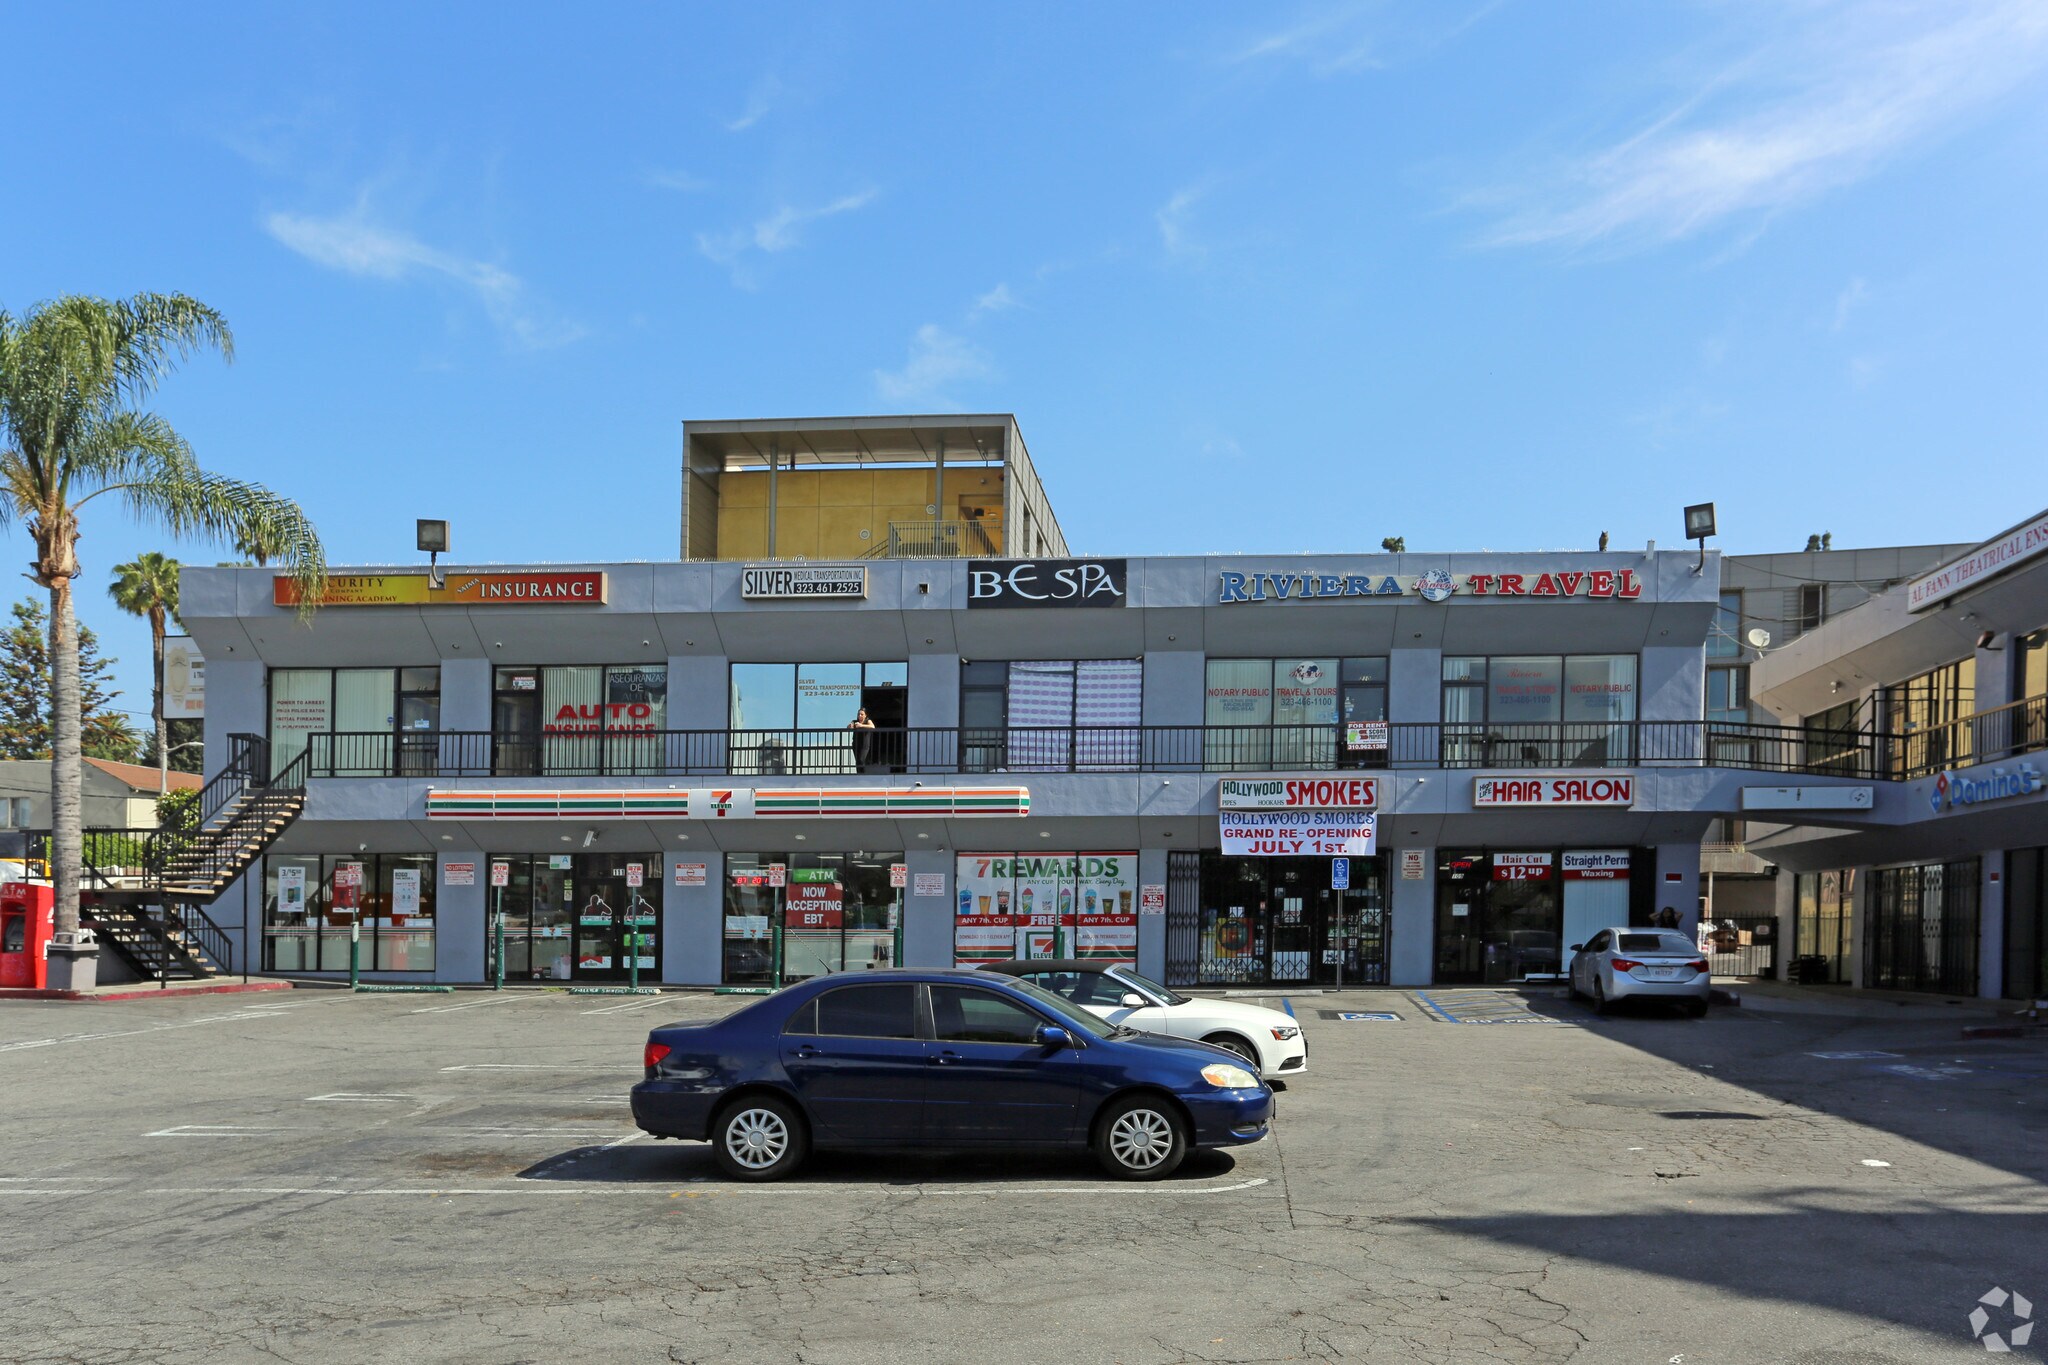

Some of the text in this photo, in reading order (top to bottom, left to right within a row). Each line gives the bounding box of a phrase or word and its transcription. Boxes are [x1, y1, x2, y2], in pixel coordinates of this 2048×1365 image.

[1912, 586, 1923, 604] AL
[1926, 571, 1951, 597] FANN
[1956, 536, 2022, 583] THEATRICAL
[326, 577, 385, 588] CURITY
[745, 570, 792, 595] SILVER
[794, 571, 813, 580] MEDICAL
[814, 570, 853, 580] TRANSPORTATION
[969, 564, 1124, 599] BE SPA
[1220, 570, 1403, 602] RIVIERA
[1468, 568, 1642, 599] TRAVEL
[480, 582, 593, 597] INSURANCE
[796, 583, 859, 593] 323.461.2525
[609, 673, 666, 683] ASEGURANZAS
[629, 684, 643, 692] DE
[1208, 688, 1270, 696] NOTARY PUBLIC
[1277, 688, 1337, 696] TRAVEL & TOURS
[1571, 684, 1632, 693] NOTARY PUBLIC
[555, 704, 652, 720] AUTO
[544, 724, 656, 739] INSURANCE
[1951, 763, 2032, 805] Domino's
[1222, 781, 1374, 806] HOLLYWOOD SMOKES
[1493, 780, 1630, 802] HAIR SALON
[1221, 812, 1374, 825] HOLLYWOOD SMOKES
[1224, 829, 1274, 838] GRAND
[1248, 841, 1304, 853] JULY
[1502, 855, 1543, 863] Hair Cut
[1564, 854, 1629, 868] Straight Perm
[977, 858, 1120, 878] 7REWARDS
[1501, 866, 1543, 879] $12 up
[809, 872, 834, 880] ATM
[1581, 870, 1614, 878] Waxing
[1095, 878, 1112, 886] Every
[803, 887, 826, 897] NOW
[786, 900, 842, 910] ACCEPTING
[804, 913, 824, 924] EBT
[1030, 915, 1062, 925] FREE
